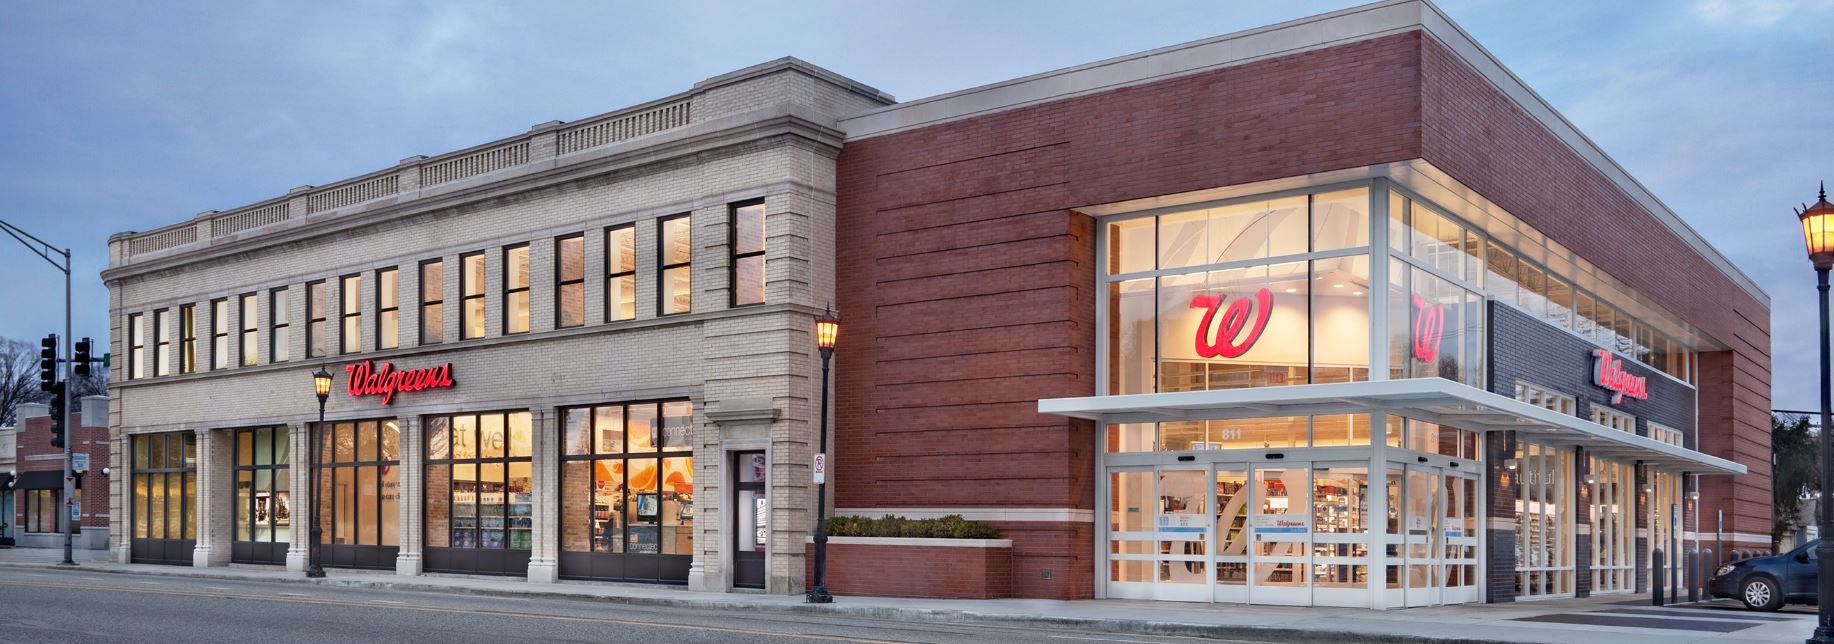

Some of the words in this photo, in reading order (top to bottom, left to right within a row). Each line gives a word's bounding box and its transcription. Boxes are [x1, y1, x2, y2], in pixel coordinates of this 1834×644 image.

[1189, 287, 1274, 358] W
[345, 359, 455, 405] Walgreens
[1597, 347, 1648, 404] Walgreens
[474, 426, 512, 451] wel
[1221, 428, 1240, 440] 811
